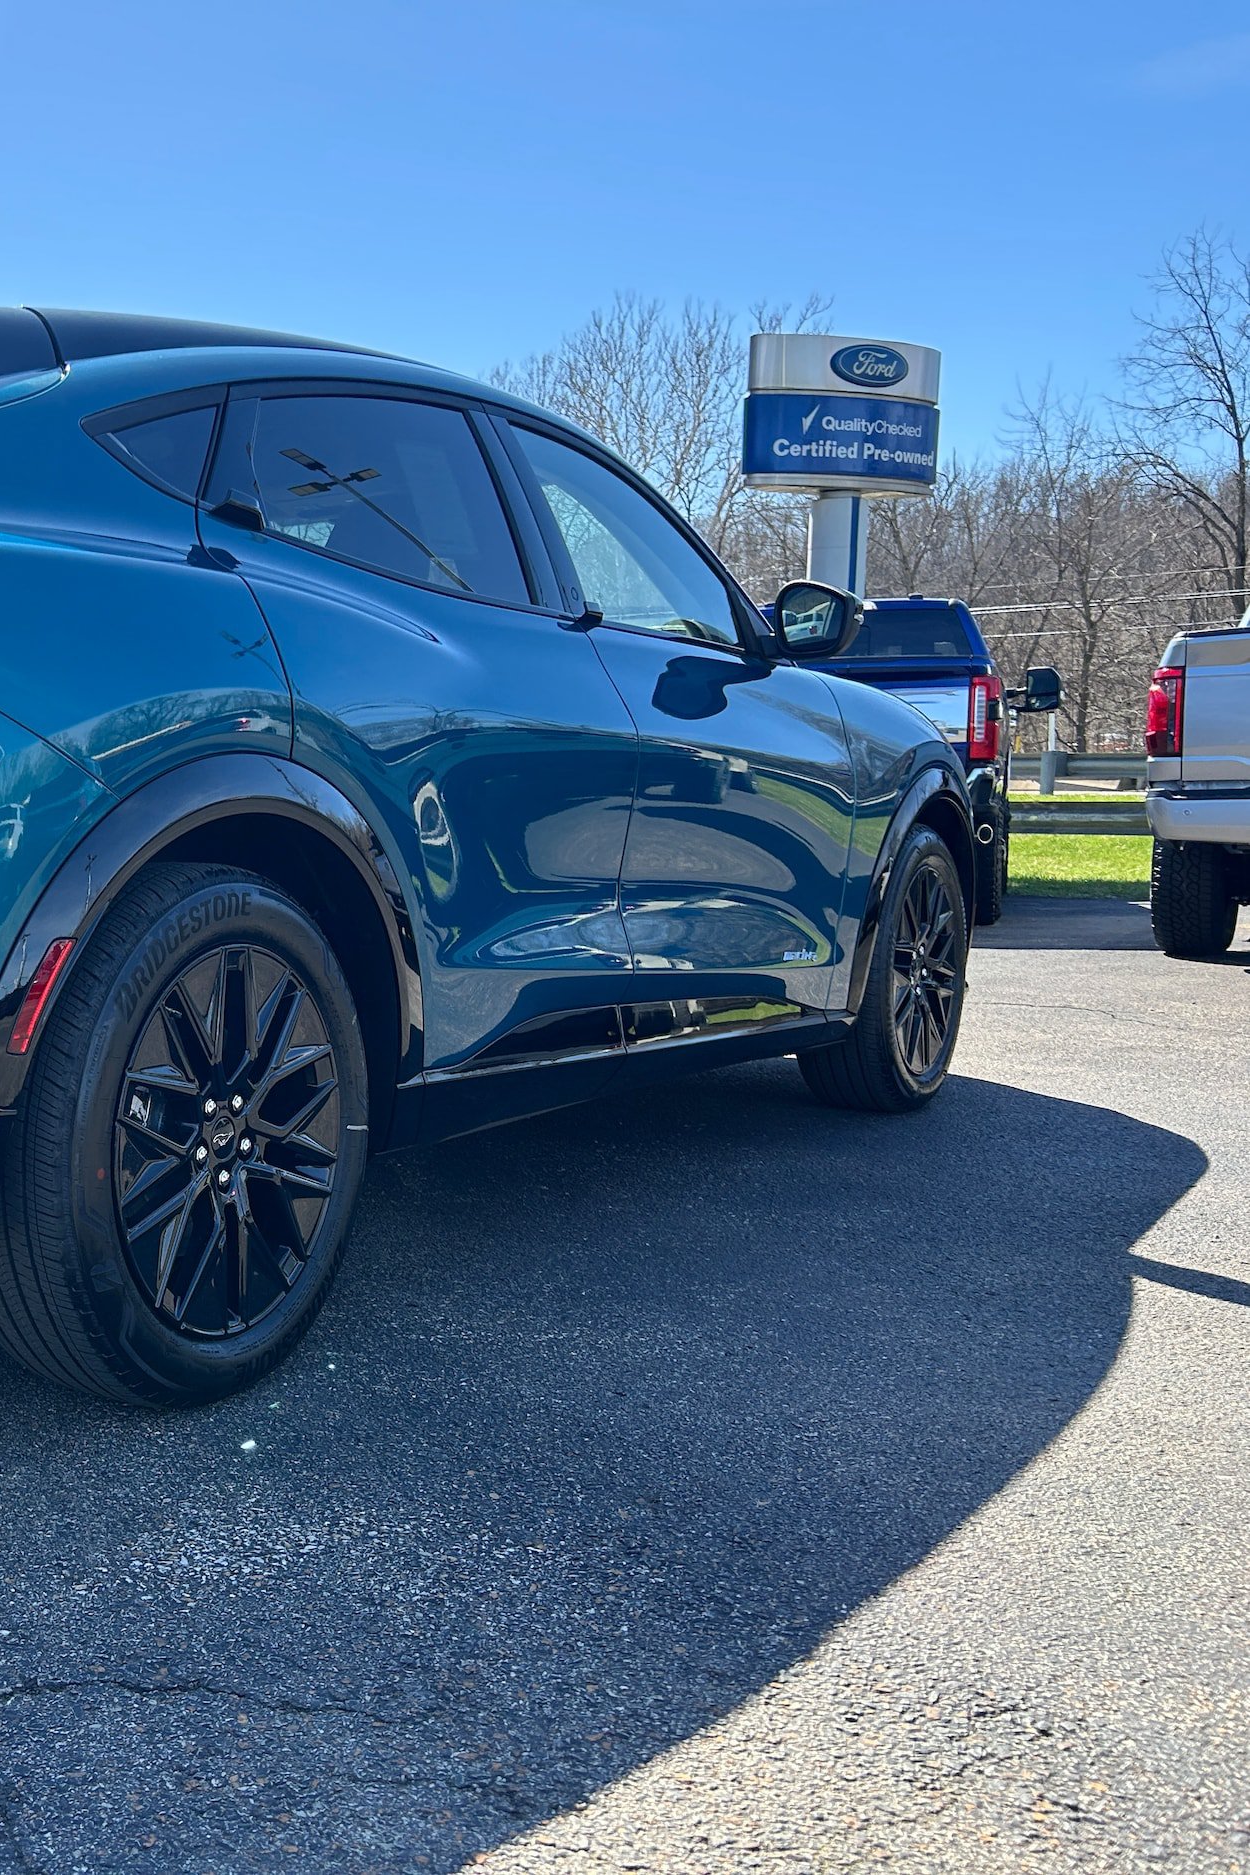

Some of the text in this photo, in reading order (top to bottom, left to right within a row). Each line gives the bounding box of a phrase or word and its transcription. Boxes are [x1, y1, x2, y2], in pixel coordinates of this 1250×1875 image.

[852, 350, 897, 379] Ford
[821, 416, 922, 438] QualityChecked
[772, 438, 934, 467] Certified Pre-owned
[115, 892, 252, 1024] BRIDGESTONE
